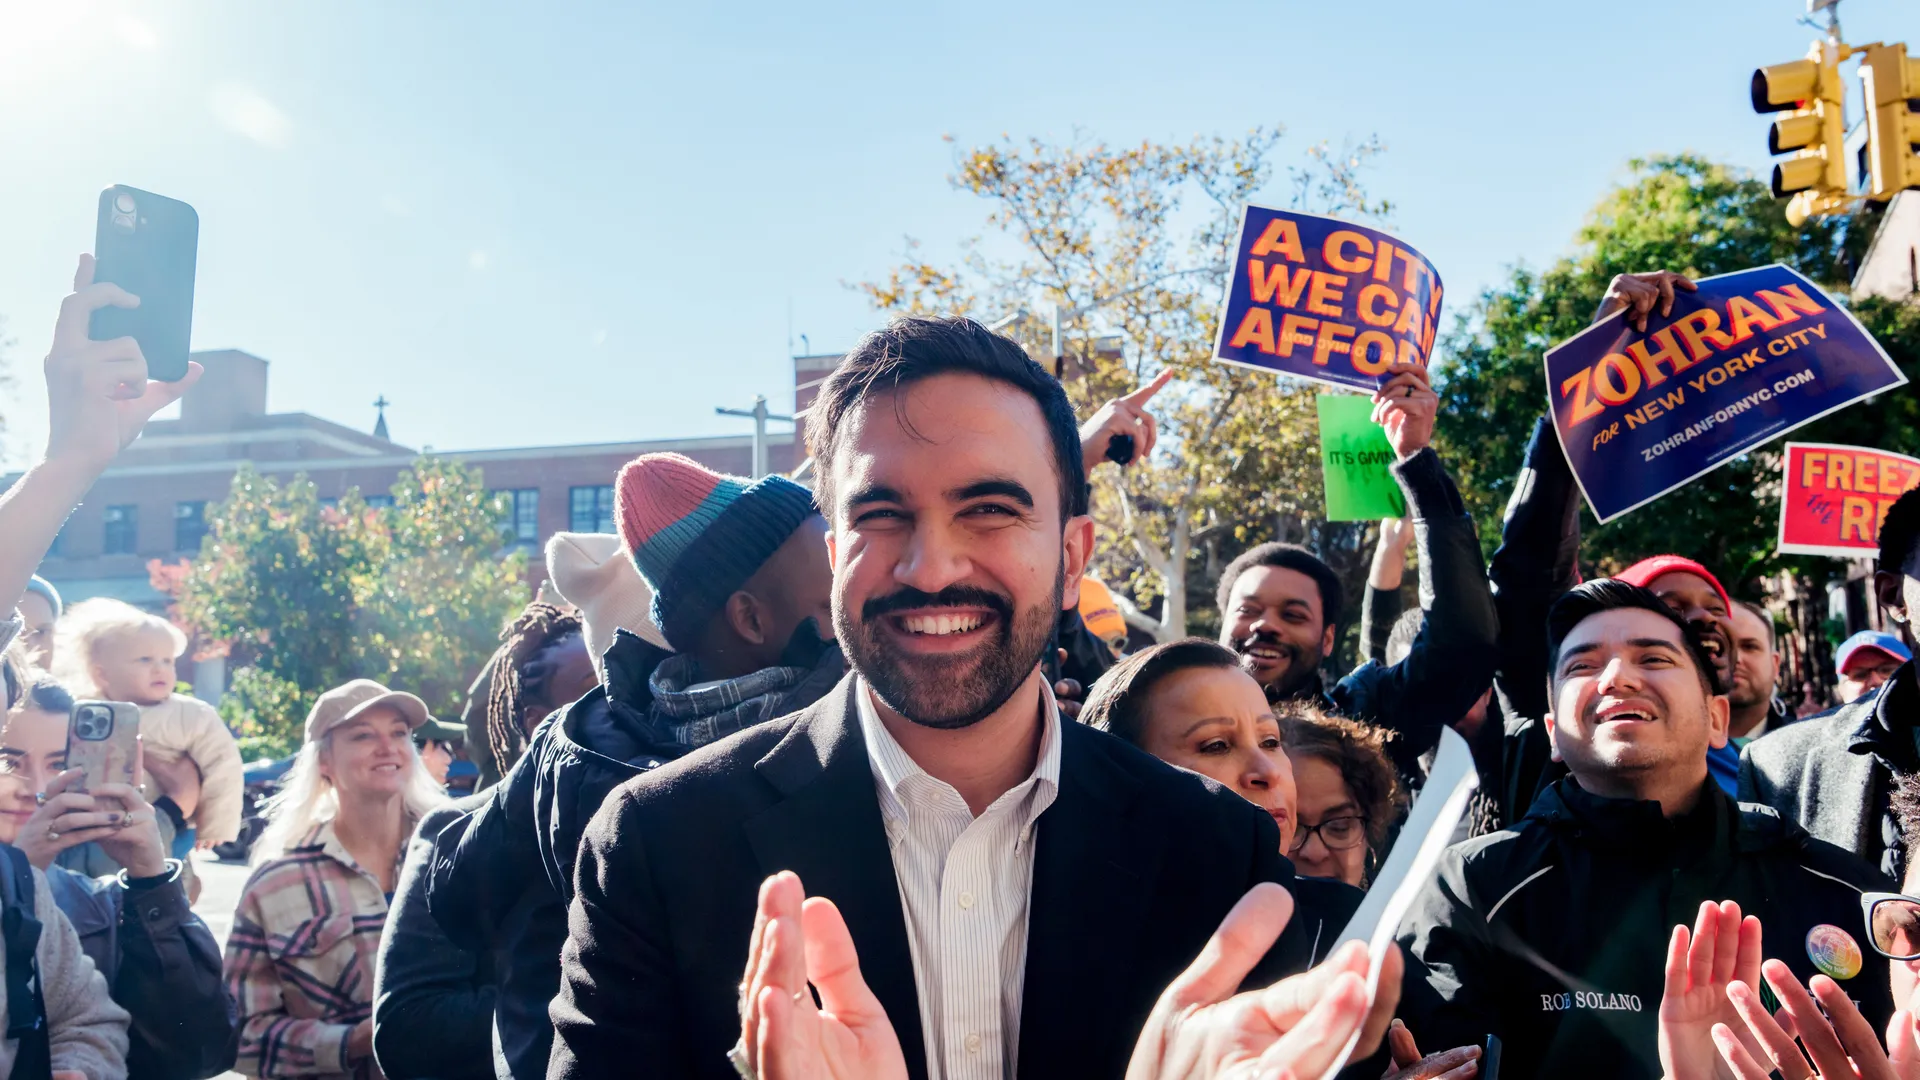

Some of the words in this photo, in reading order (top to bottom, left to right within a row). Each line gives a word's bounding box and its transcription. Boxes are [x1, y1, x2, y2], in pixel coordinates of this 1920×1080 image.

[1248, 259, 1348, 318] WE
[1357, 283, 1436, 366] CAN
[1250, 218, 1305, 263] A
[1322, 230, 1444, 318] CITY
[1560, 283, 1827, 430] ZOHRAN
[1592, 422, 1620, 452] FOR
[1624, 387, 1686, 431] NEW
[1688, 347, 1767, 394] YORK
[1767, 323, 1828, 357] CITY
[1640, 368, 1817, 463] ZOHRANFORNYC.COM
[1540, 992, 1571, 1011] ROB
[1575, 991, 1642, 1012] SOLANO
